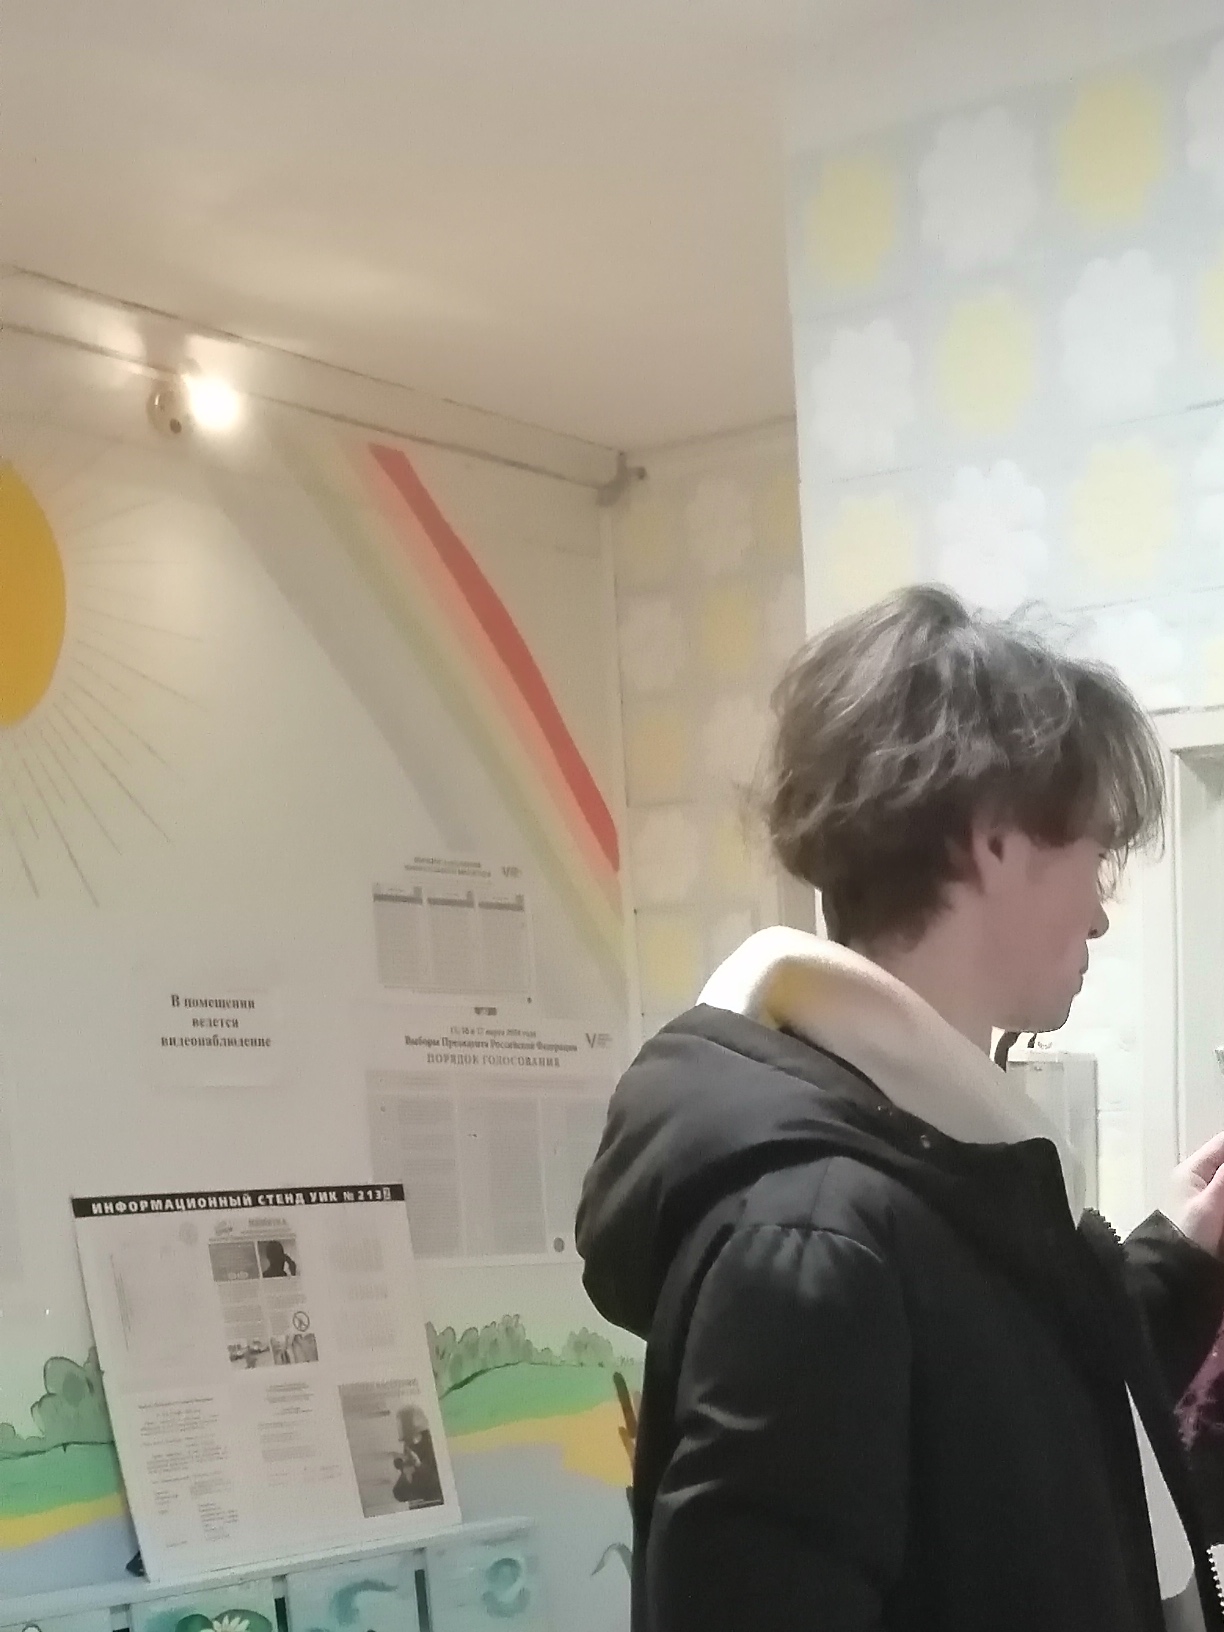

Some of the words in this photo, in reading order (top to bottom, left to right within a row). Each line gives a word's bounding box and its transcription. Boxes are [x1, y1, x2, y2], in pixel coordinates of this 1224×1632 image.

[171, 994, 180, 1007] В
[92, 1193, 252, 1215] ИНФОРМАЦИОННЫЙ
[258, 1193, 306, 1206] СТЕНД
[309, 1191, 338, 1203] УИК
[343, 1190, 354, 1201] №
